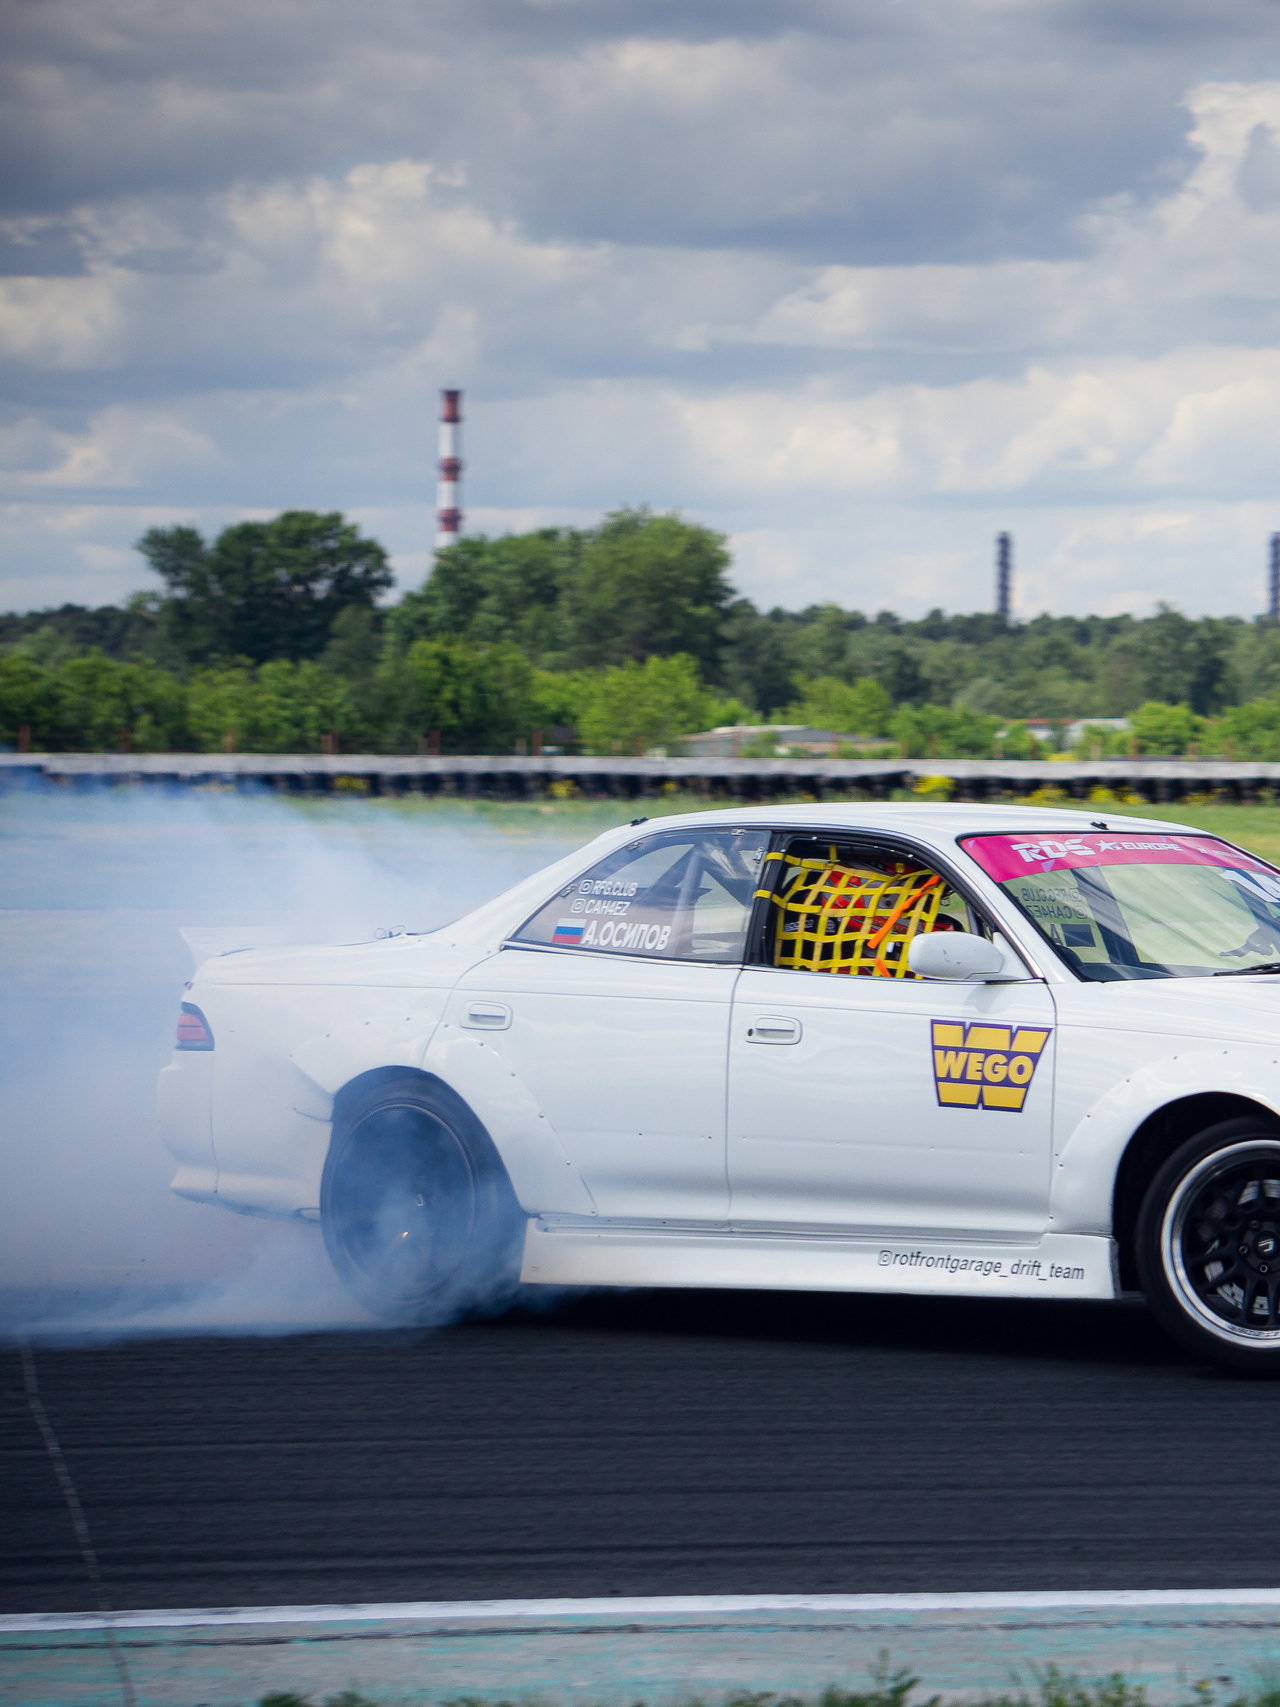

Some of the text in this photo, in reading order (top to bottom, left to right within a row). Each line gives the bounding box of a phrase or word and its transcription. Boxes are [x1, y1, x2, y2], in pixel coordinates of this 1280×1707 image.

[1011, 838, 1184, 863] RDS EUROPE
[580, 920, 672, 951] А.ОСИПОВ
[933, 1049, 1034, 1085] WEGO
